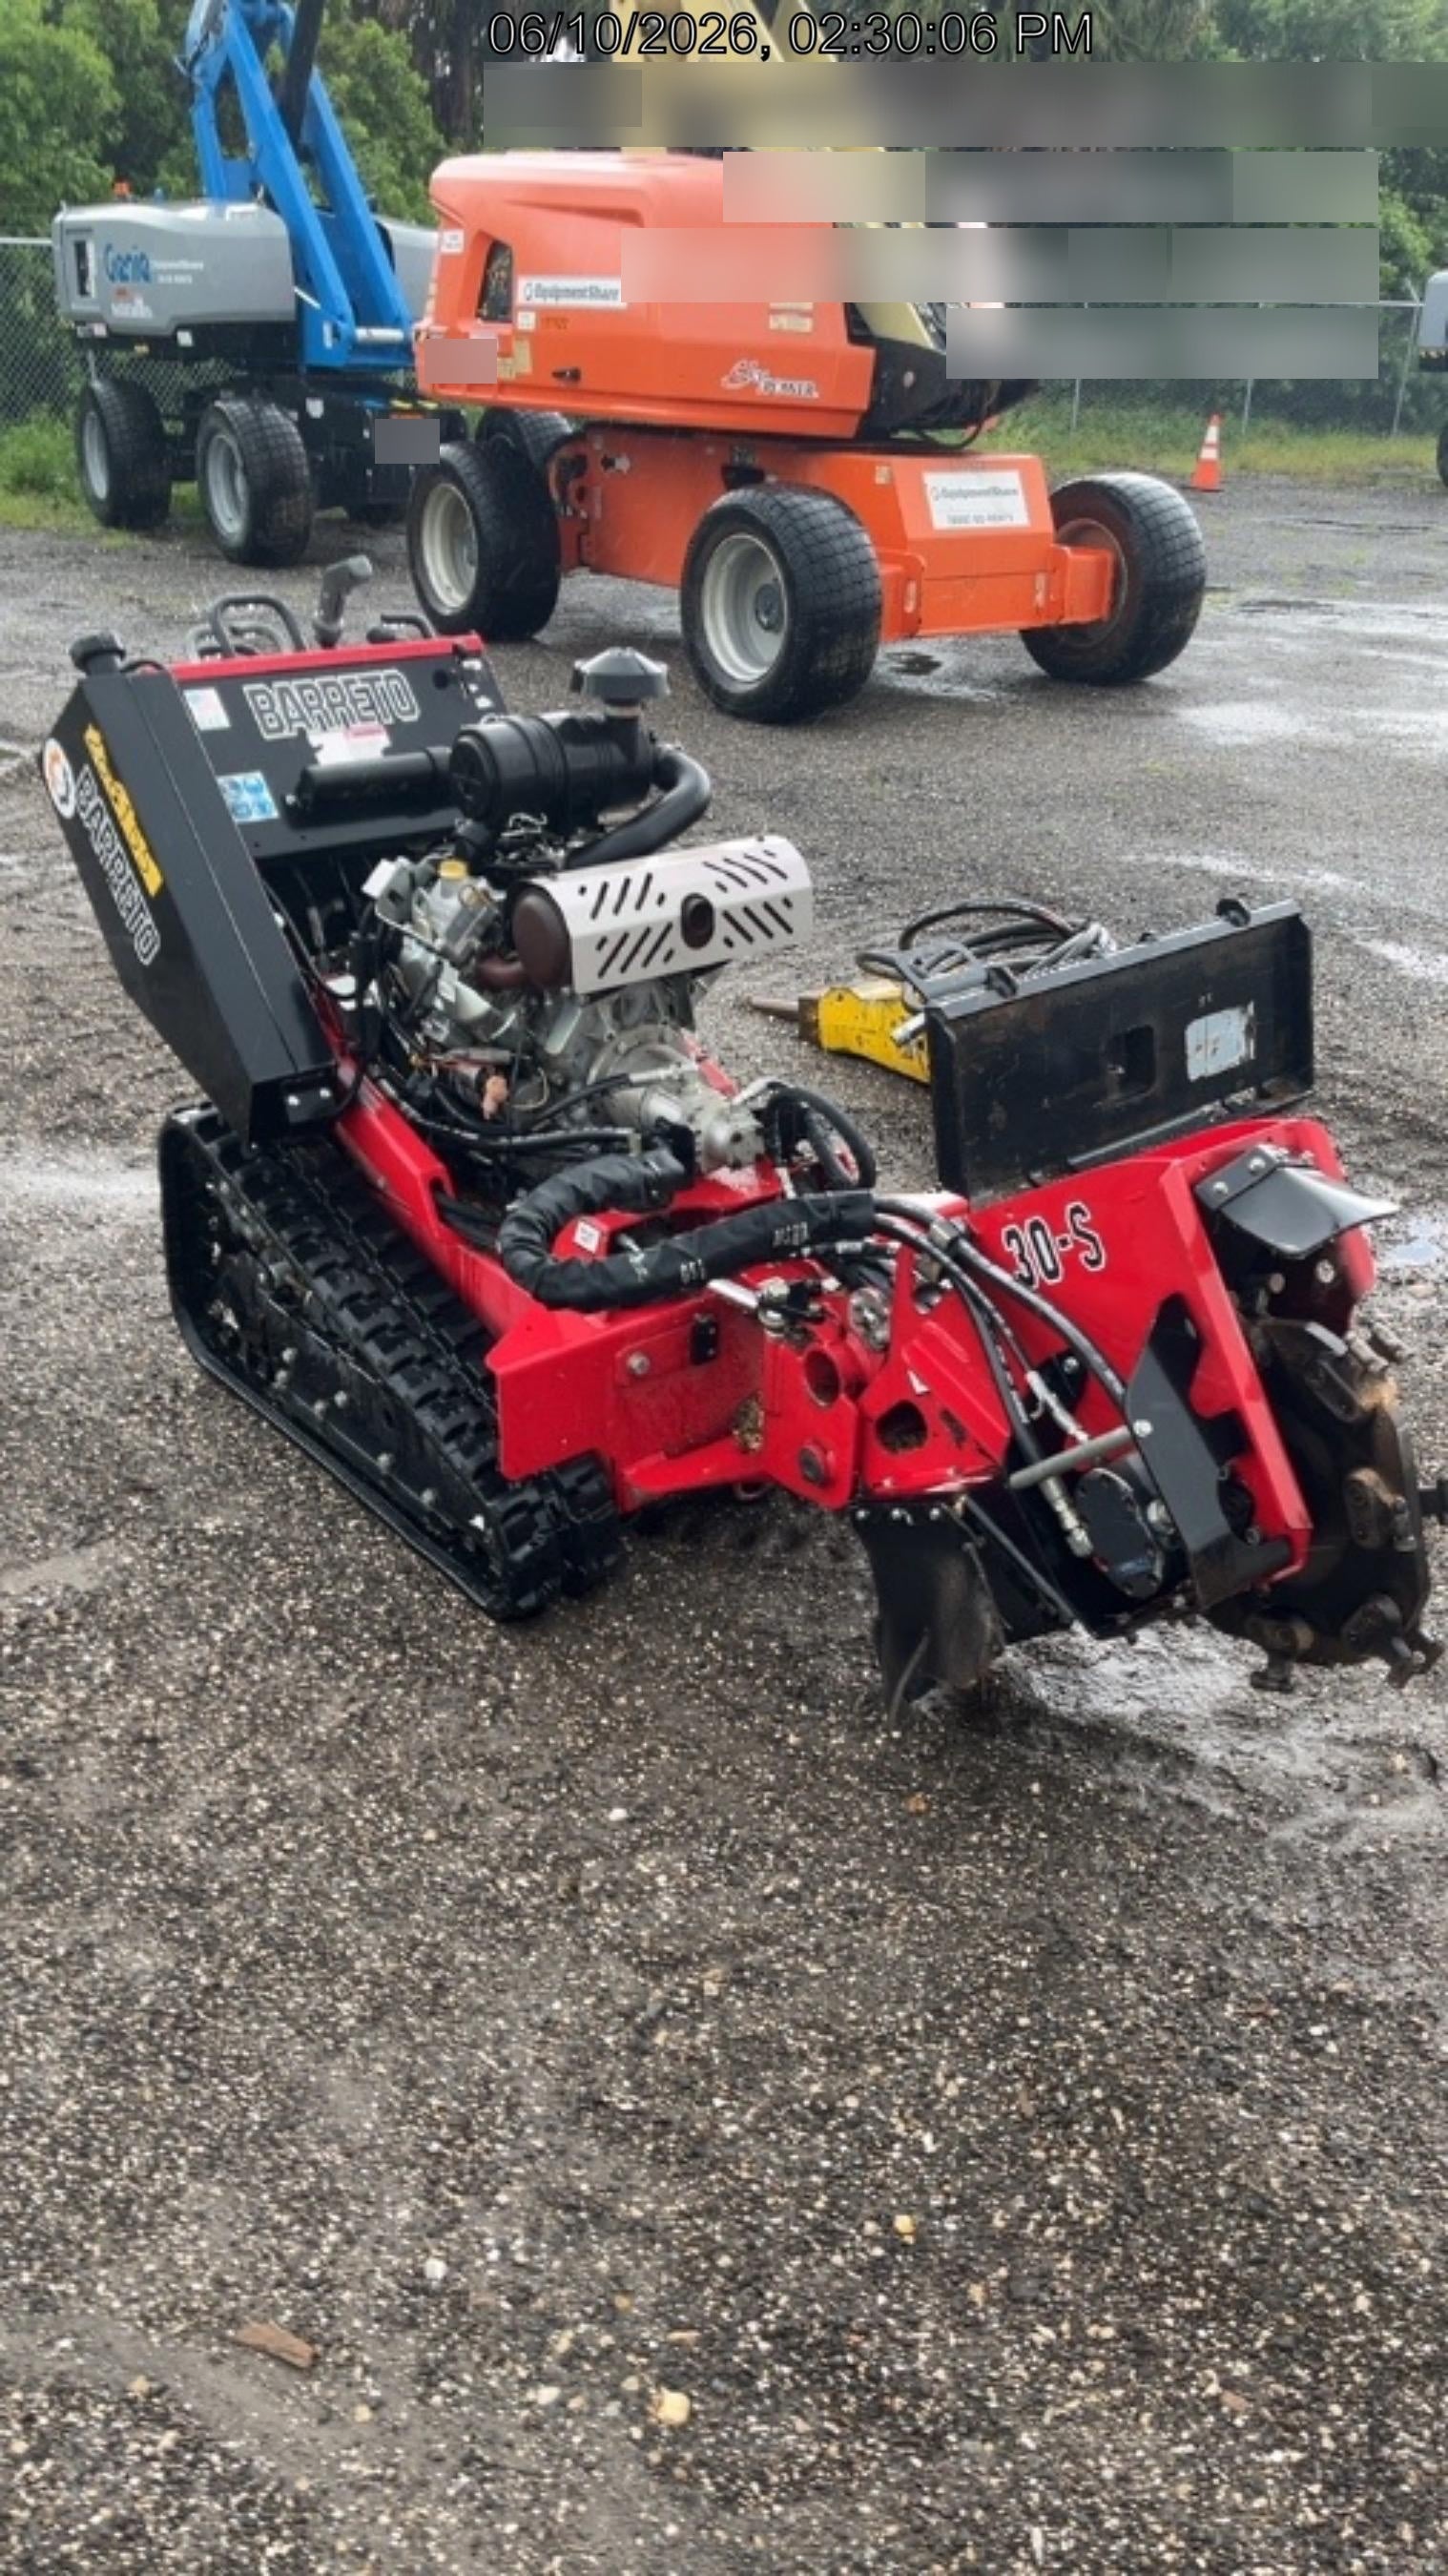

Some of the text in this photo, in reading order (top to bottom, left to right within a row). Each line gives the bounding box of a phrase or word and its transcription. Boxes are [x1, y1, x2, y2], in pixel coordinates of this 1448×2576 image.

[242, 668, 422, 740] BARRETO
[76, 764, 160, 966] BARRETO
[1002, 1201, 1107, 1289] 30-S
